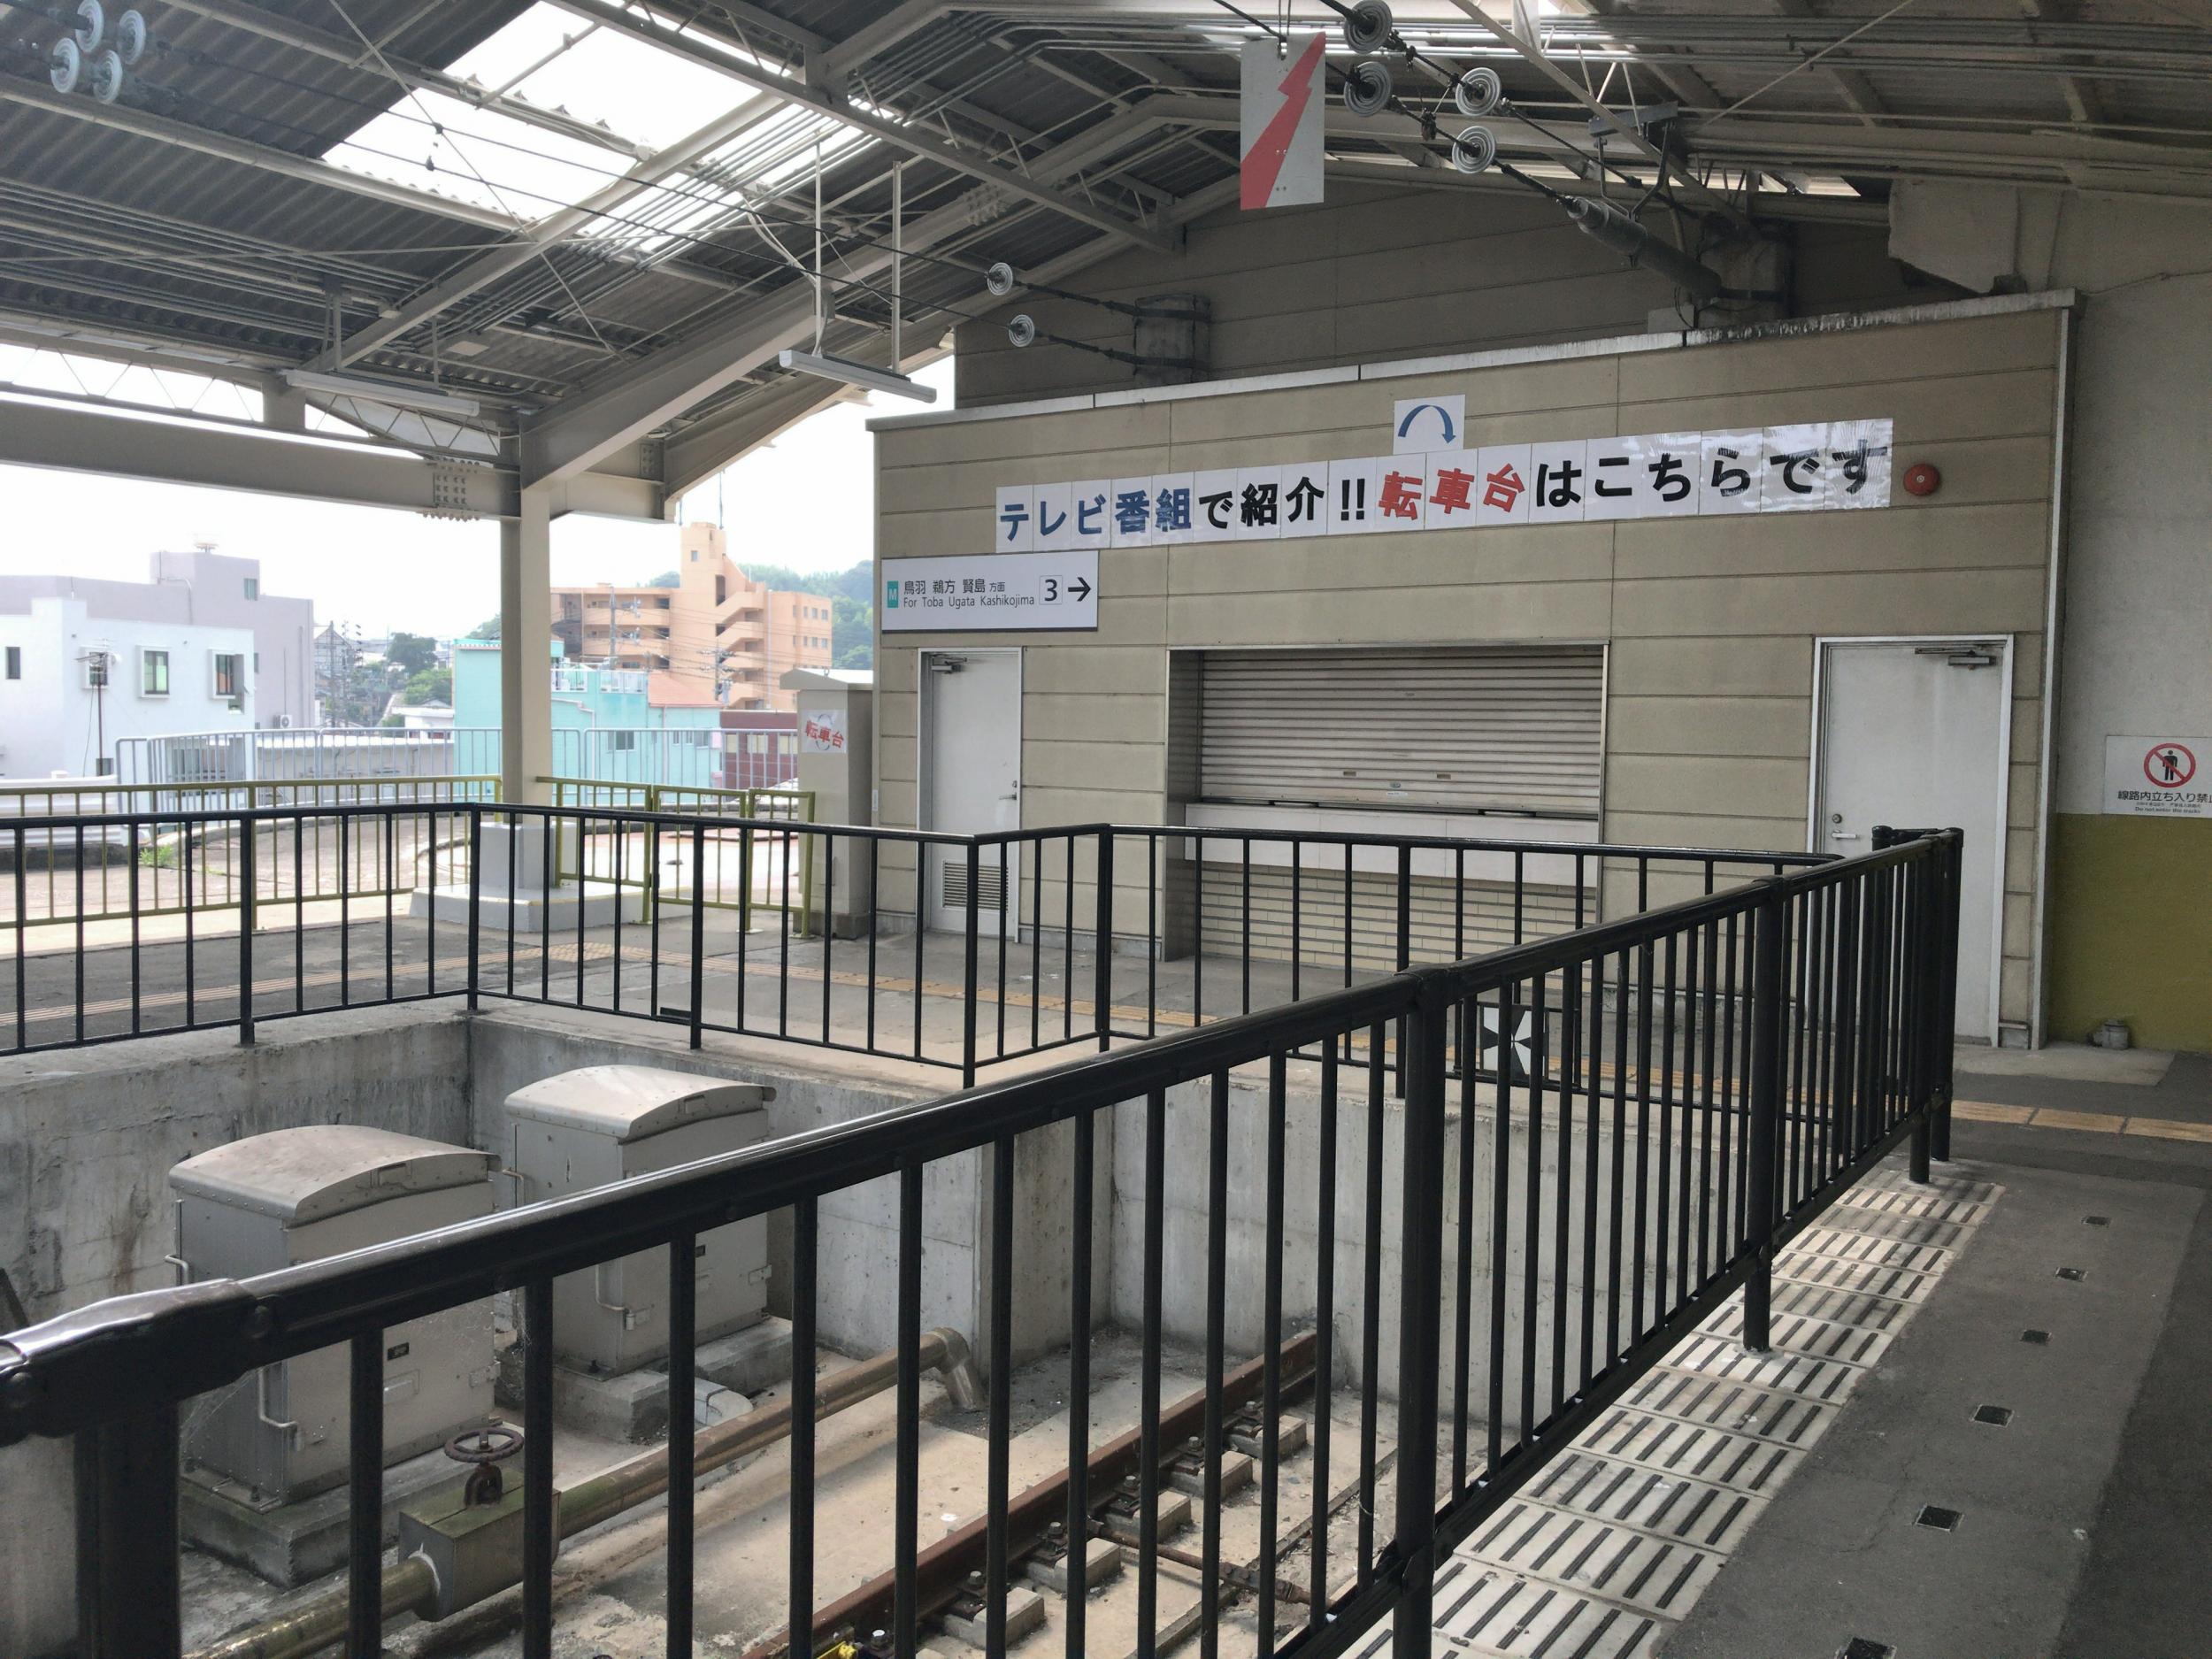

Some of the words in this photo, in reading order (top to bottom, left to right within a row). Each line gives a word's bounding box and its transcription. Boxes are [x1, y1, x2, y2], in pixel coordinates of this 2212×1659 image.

[903, 580, 926, 595] 鳥羽
[933, 579, 956, 594] 鵜方
[962, 578, 986, 594] 賢島
[989, 581, 1006, 593] 方面
[1044, 578, 1058, 602] 3
[903, 596, 918, 608] For
[922, 595, 943, 608] Toba
[949, 595, 975, 610] Ugata
[979, 594, 1034, 609] Kashikojima
[805, 720, 844, 749] 転車台
